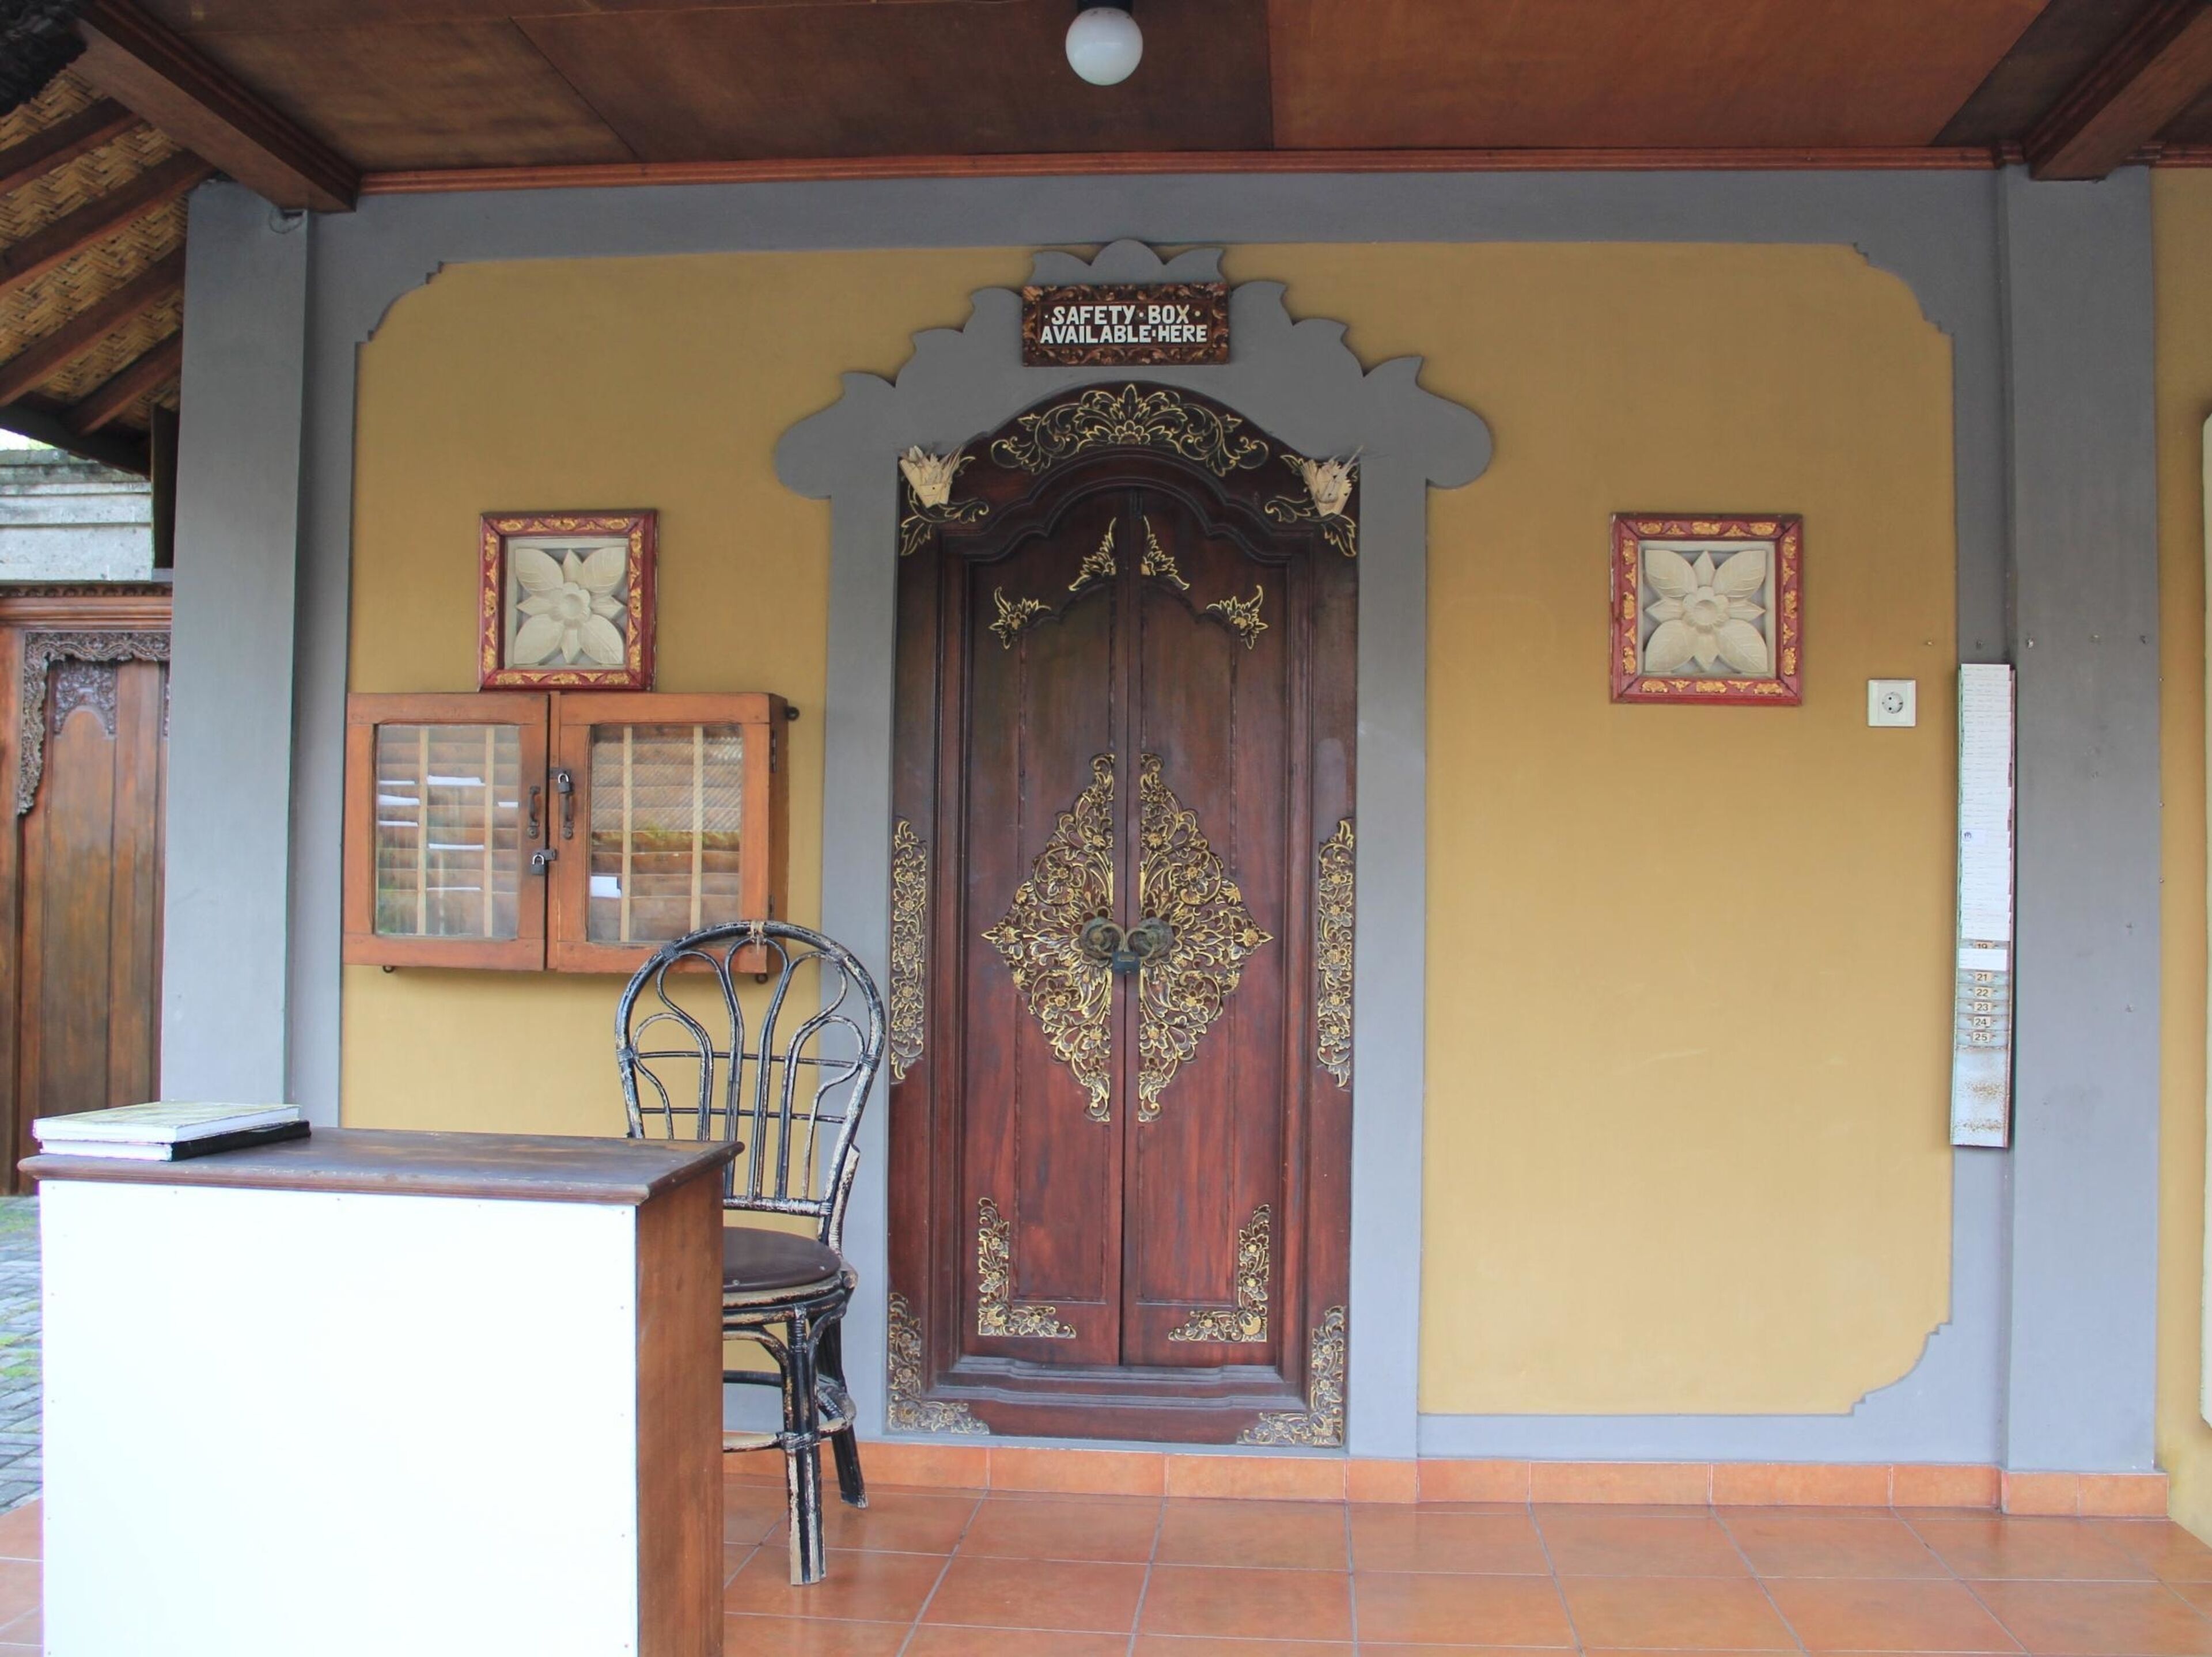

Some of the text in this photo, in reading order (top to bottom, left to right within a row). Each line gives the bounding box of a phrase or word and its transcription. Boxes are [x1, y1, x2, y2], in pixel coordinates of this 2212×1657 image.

[1051, 305, 1190, 325] SAFETY BOX
[1040, 325, 1207, 344] AVAILABLE HERE
[1976, 973, 1987, 981] 21
[1976, 988, 1988, 997] 22
[1976, 1003, 1988, 1011] 23
[1975, 1018, 1987, 1026] 24
[1974, 1033, 1987, 1041] 25
